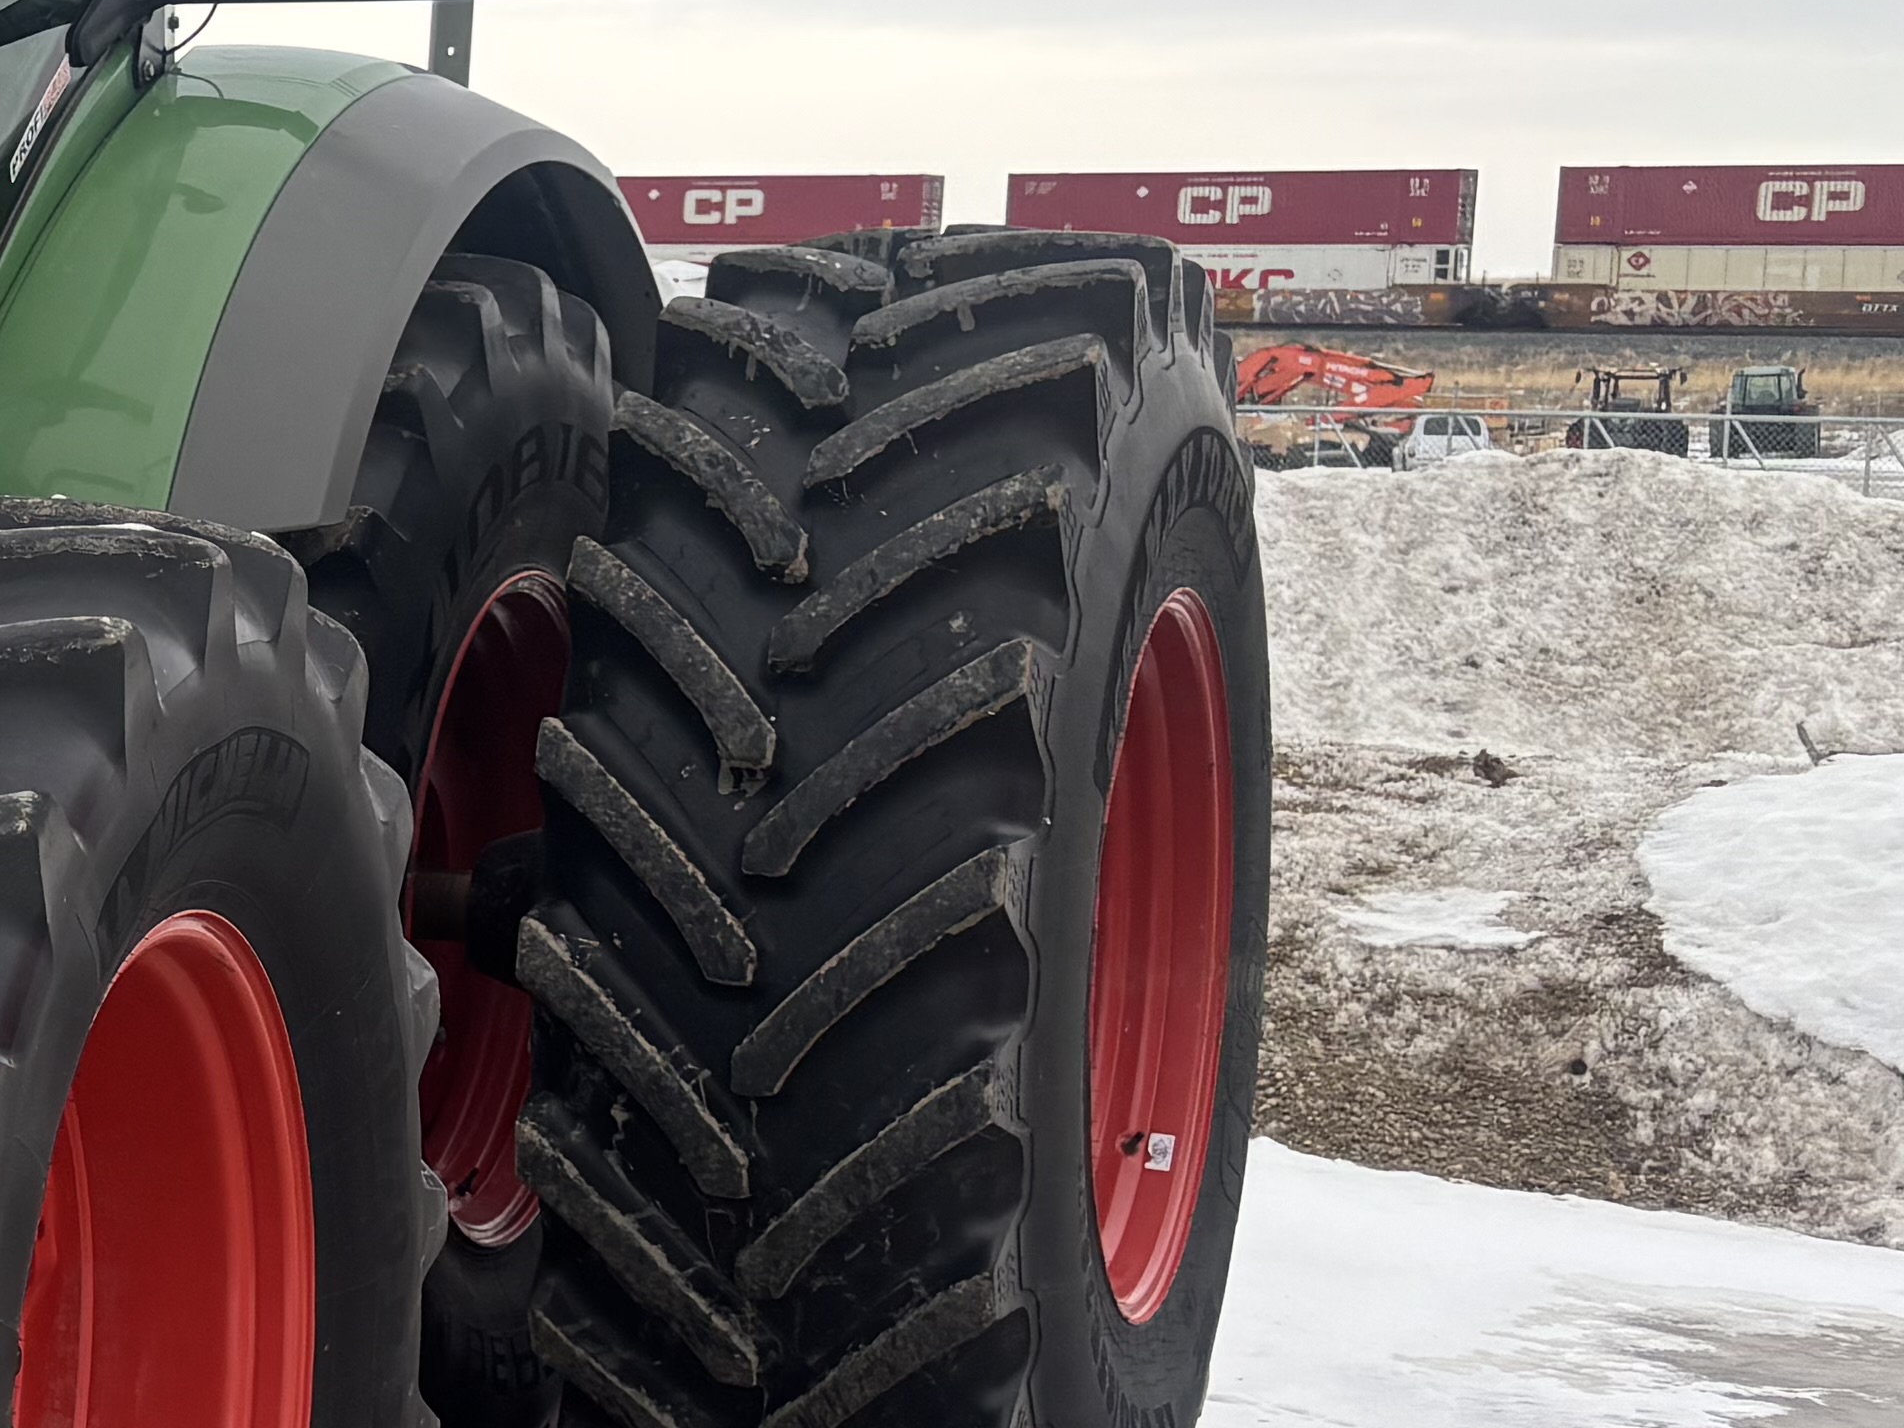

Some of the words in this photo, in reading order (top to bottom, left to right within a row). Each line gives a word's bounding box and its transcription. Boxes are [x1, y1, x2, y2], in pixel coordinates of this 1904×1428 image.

[682, 188, 765, 226] CP
[1176, 185, 1273, 225] CP
[1755, 180, 1867, 222] CP
